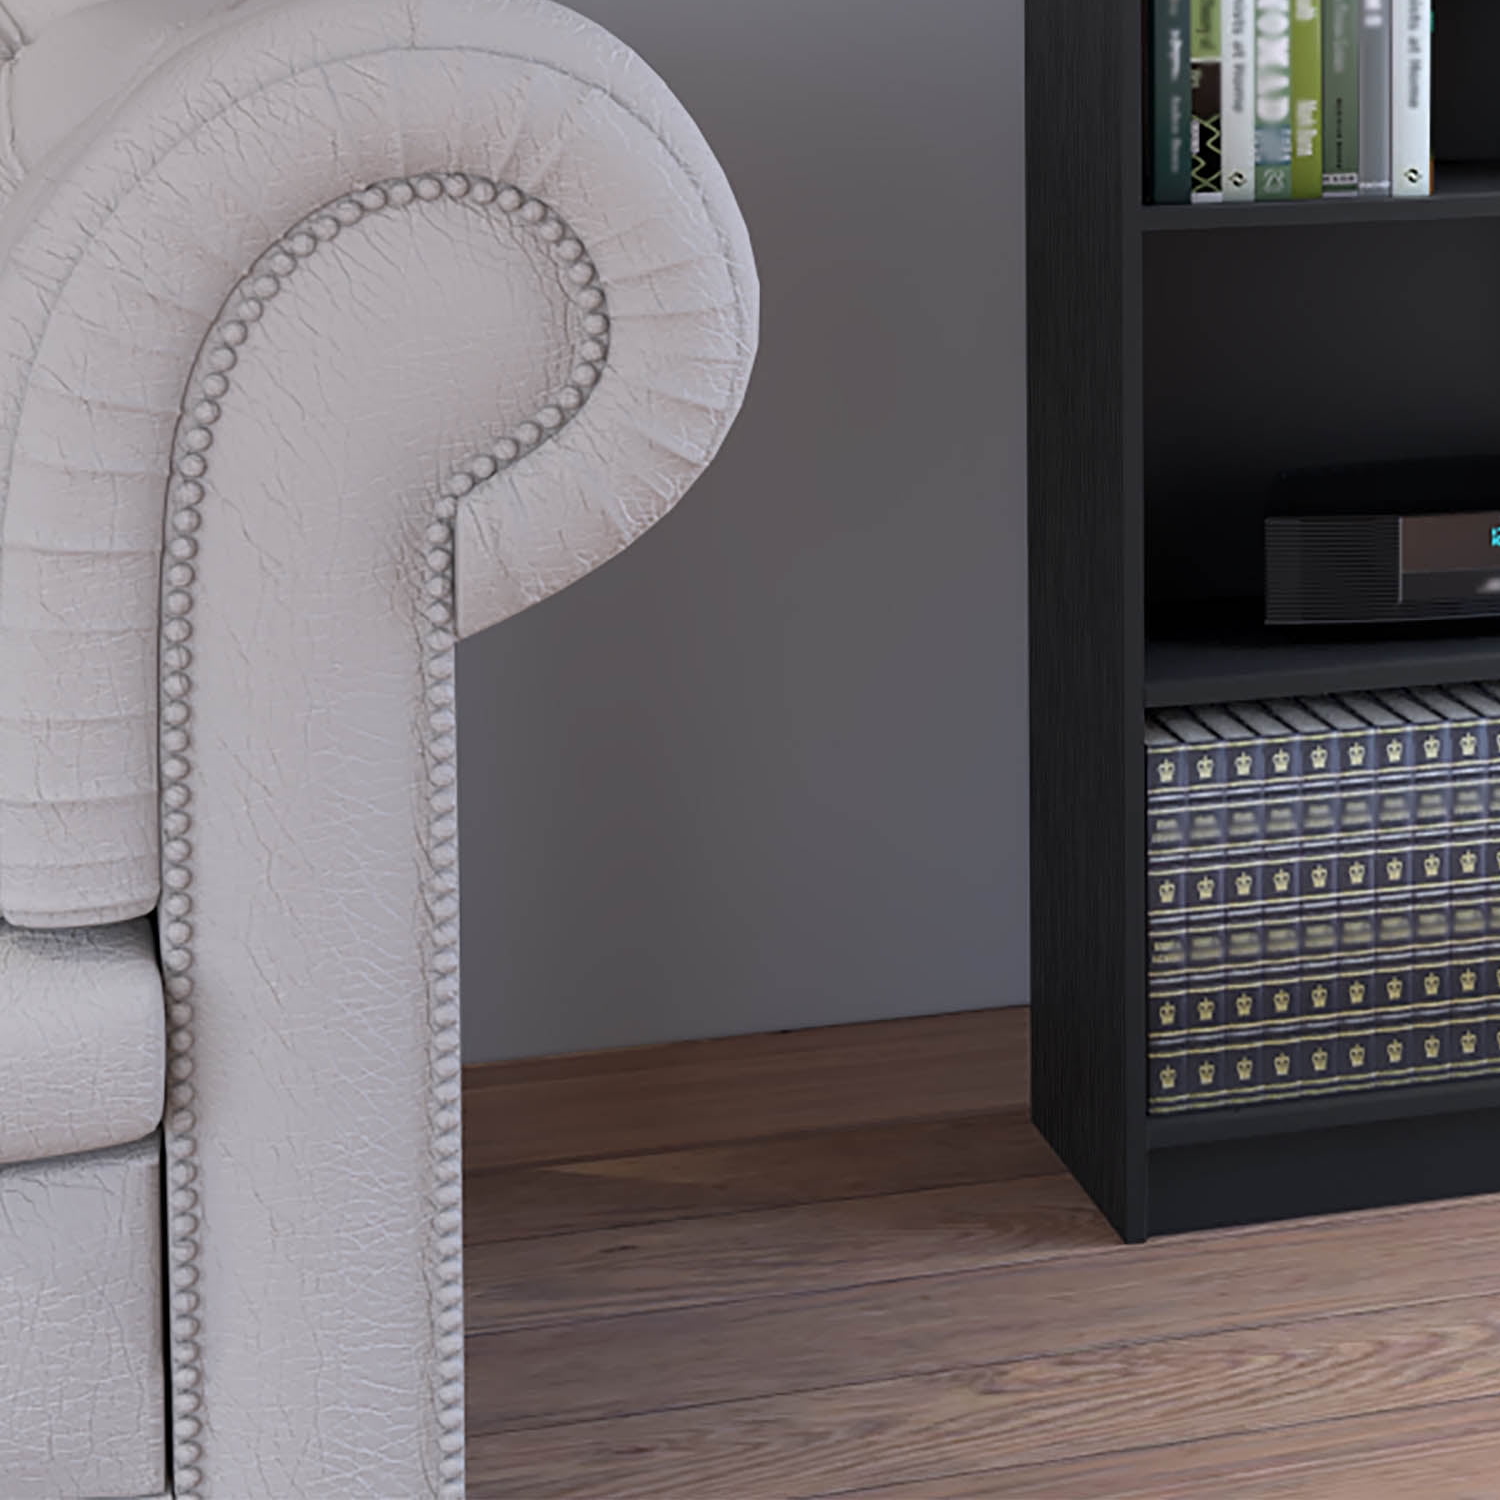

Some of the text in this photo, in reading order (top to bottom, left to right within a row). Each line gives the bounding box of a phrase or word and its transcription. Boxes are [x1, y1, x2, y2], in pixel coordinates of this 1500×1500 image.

[1231, 41, 1245, 58] at
[1408, 37, 1421, 53] at
[1231, 63, 1245, 112] Home
[1408, 59, 1421, 108] Home
